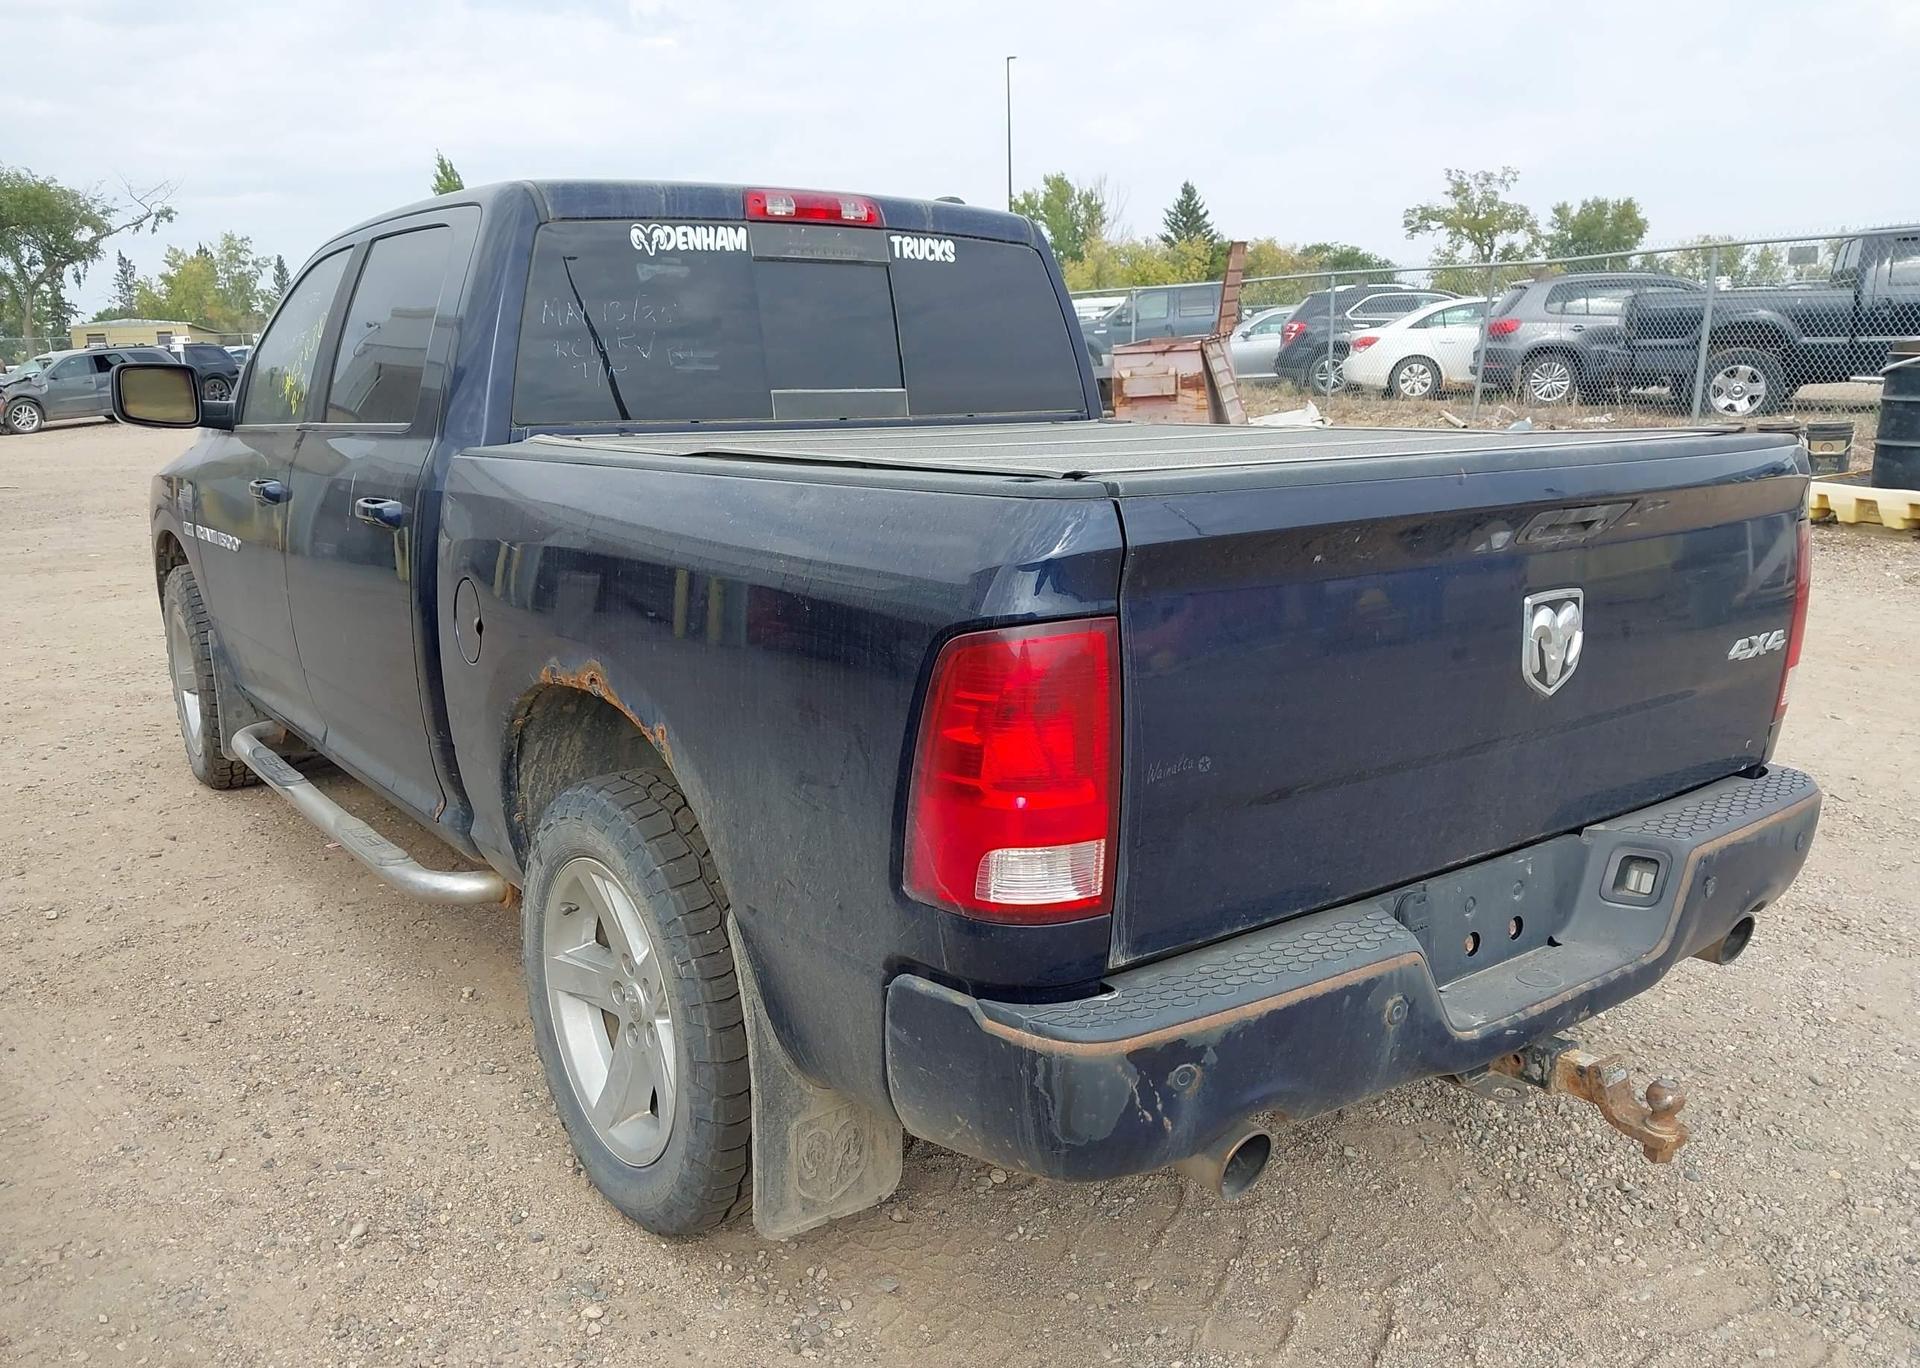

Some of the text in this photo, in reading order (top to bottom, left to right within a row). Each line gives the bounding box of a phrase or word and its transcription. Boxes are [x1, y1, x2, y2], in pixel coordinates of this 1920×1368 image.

[662, 225, 748, 252] DENHAM
[889, 234, 957, 264] TRUCKS
[1727, 629, 1787, 661] 4X4
